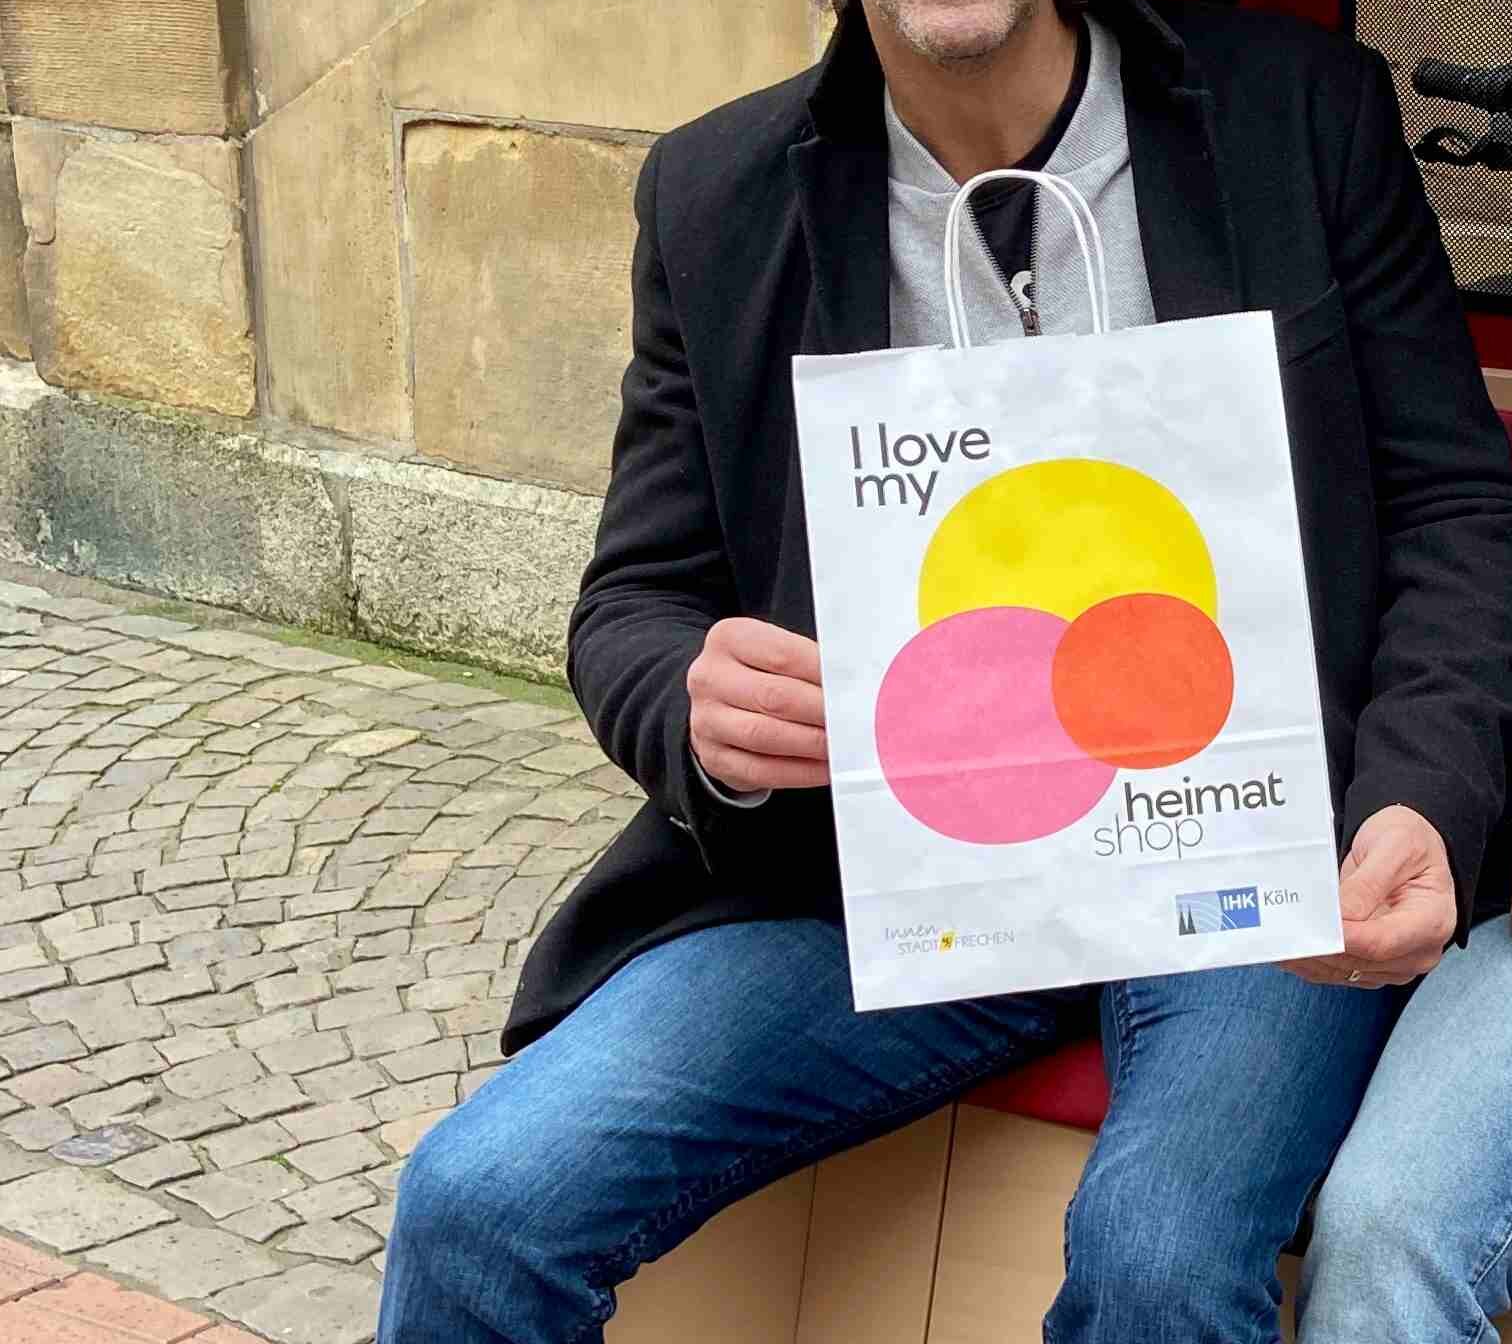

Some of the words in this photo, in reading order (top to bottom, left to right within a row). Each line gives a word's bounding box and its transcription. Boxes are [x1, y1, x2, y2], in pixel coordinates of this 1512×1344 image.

[850, 426, 862, 469] I
[878, 422, 991, 469] love
[854, 470, 939, 516] my
[1124, 771, 1286, 822] heimat
[1094, 813, 1204, 860] shop
[1222, 892, 1257, 911] IHK
[1263, 889, 1300, 907] Köln
[897, 938, 938, 955] STADT
[954, 929, 1016, 949] FRECHEN
